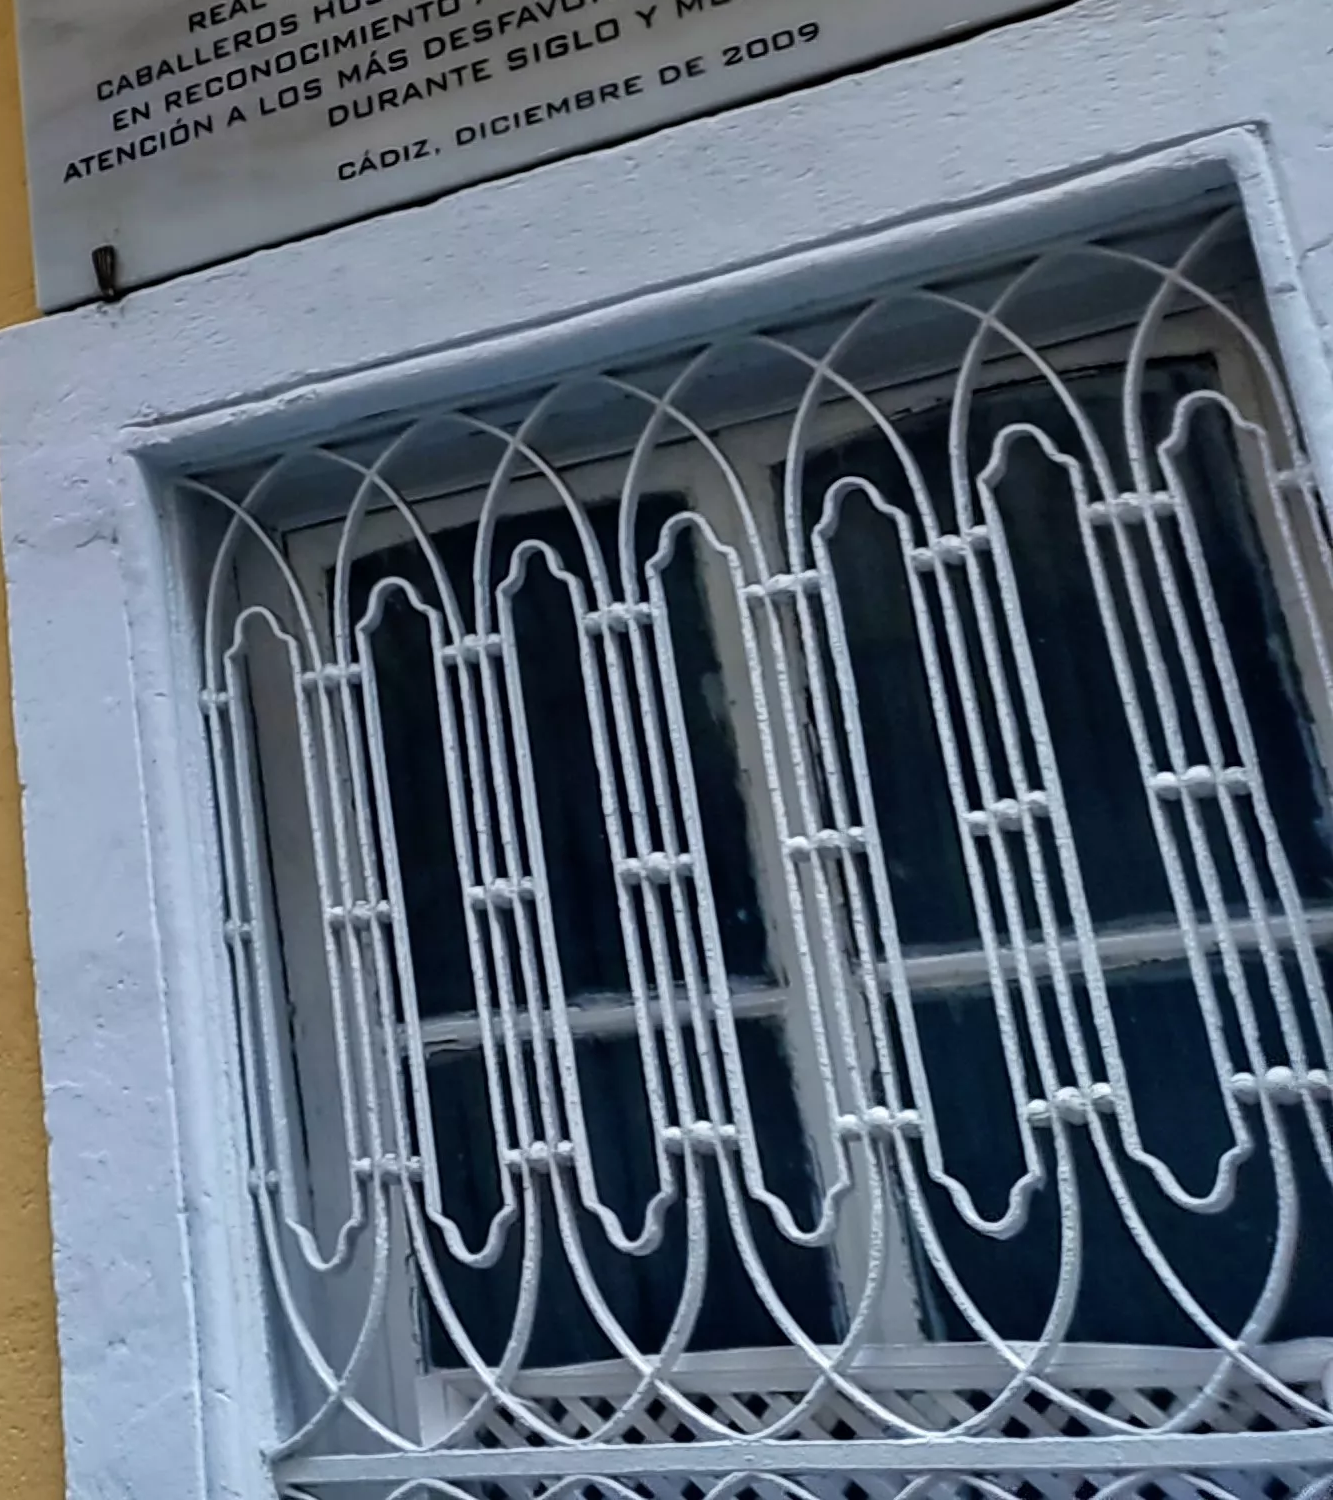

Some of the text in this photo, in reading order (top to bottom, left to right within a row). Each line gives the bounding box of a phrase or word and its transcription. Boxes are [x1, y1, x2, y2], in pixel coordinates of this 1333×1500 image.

[62, 113, 214, 184] ATENCIÓN
[225, 104, 247, 128] A
[258, 76, 323, 117] LOS
[336, 47, 409, 89] MÁS
[95, 12, 299, 102] CABALLEROS
[111, 100, 151, 132] EN
[326, 57, 493, 128] DURANTE
[505, 16, 620, 72] SIGLO
[633, 3, 658, 29] Y
[454, 74, 644, 147] DICIEMBRE
[657, 54, 706, 86] DE
[720, 20, 820, 67] 2009
